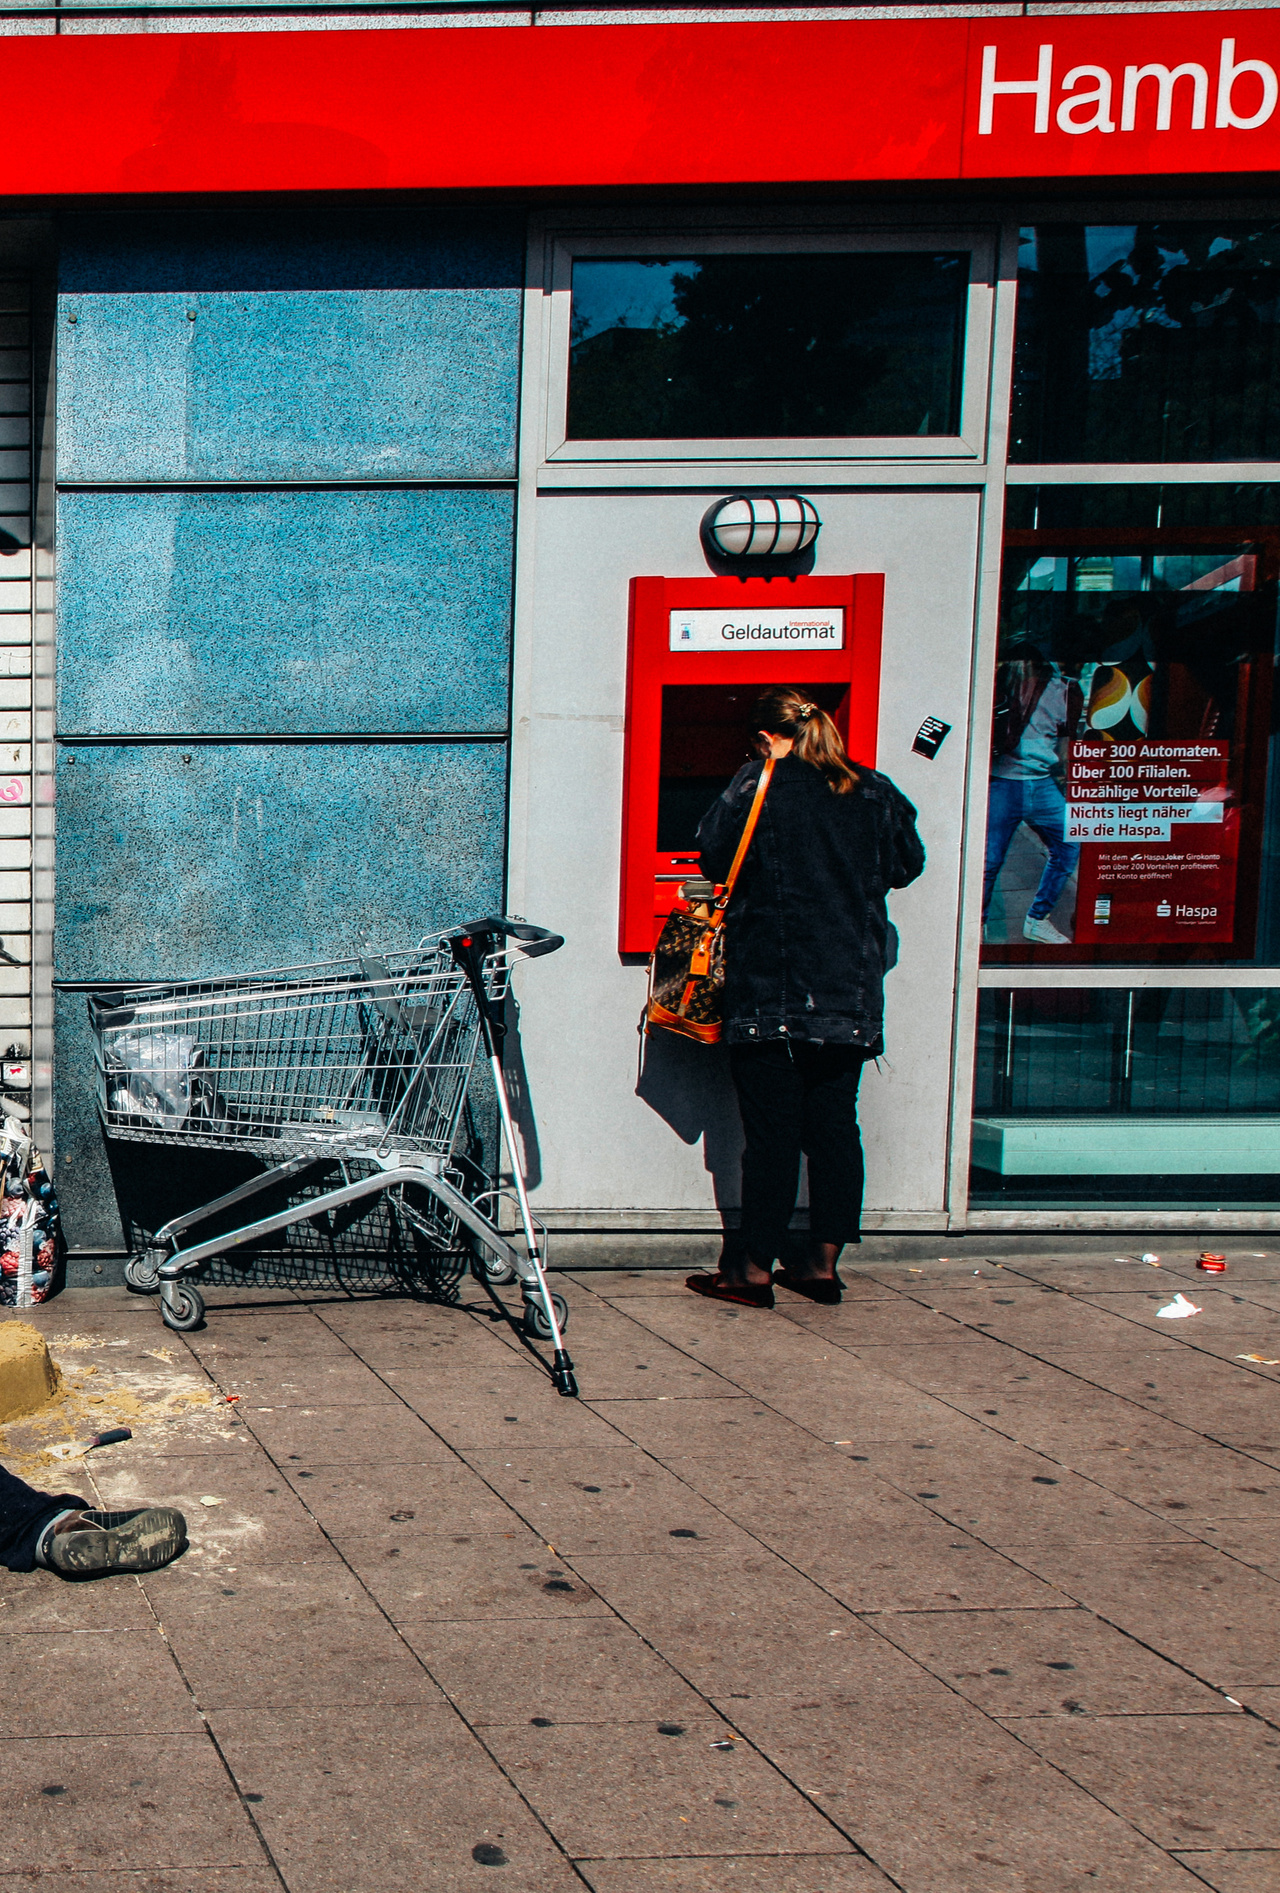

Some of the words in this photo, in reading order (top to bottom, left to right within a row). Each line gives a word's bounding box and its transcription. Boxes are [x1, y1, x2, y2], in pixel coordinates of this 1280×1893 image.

[978, 38, 1279, 135] Hamb
[721, 623, 836, 640] Geldautomat
[1073, 742, 1106, 758] Über
[1110, 745, 1136, 758] 300
[1139, 744, 1222, 758] Automaten.
[1072, 764, 1105, 779] Über
[1109, 766, 1134, 779] 100
[1138, 765, 1191, 778] Filialen.
[1071, 785, 1139, 801] Unzählige
[1143, 784, 1202, 798] Vorteile.
[1070, 806, 1114, 819] Nichts
[1118, 806, 1148, 821] liegt
[1152, 806, 1192, 819] näher
[1070, 824, 1089, 836] als
[1093, 824, 1114, 836] die
[1119, 824, 1165, 838] Haspa.
[1176, 905, 1217, 919] Haspa
